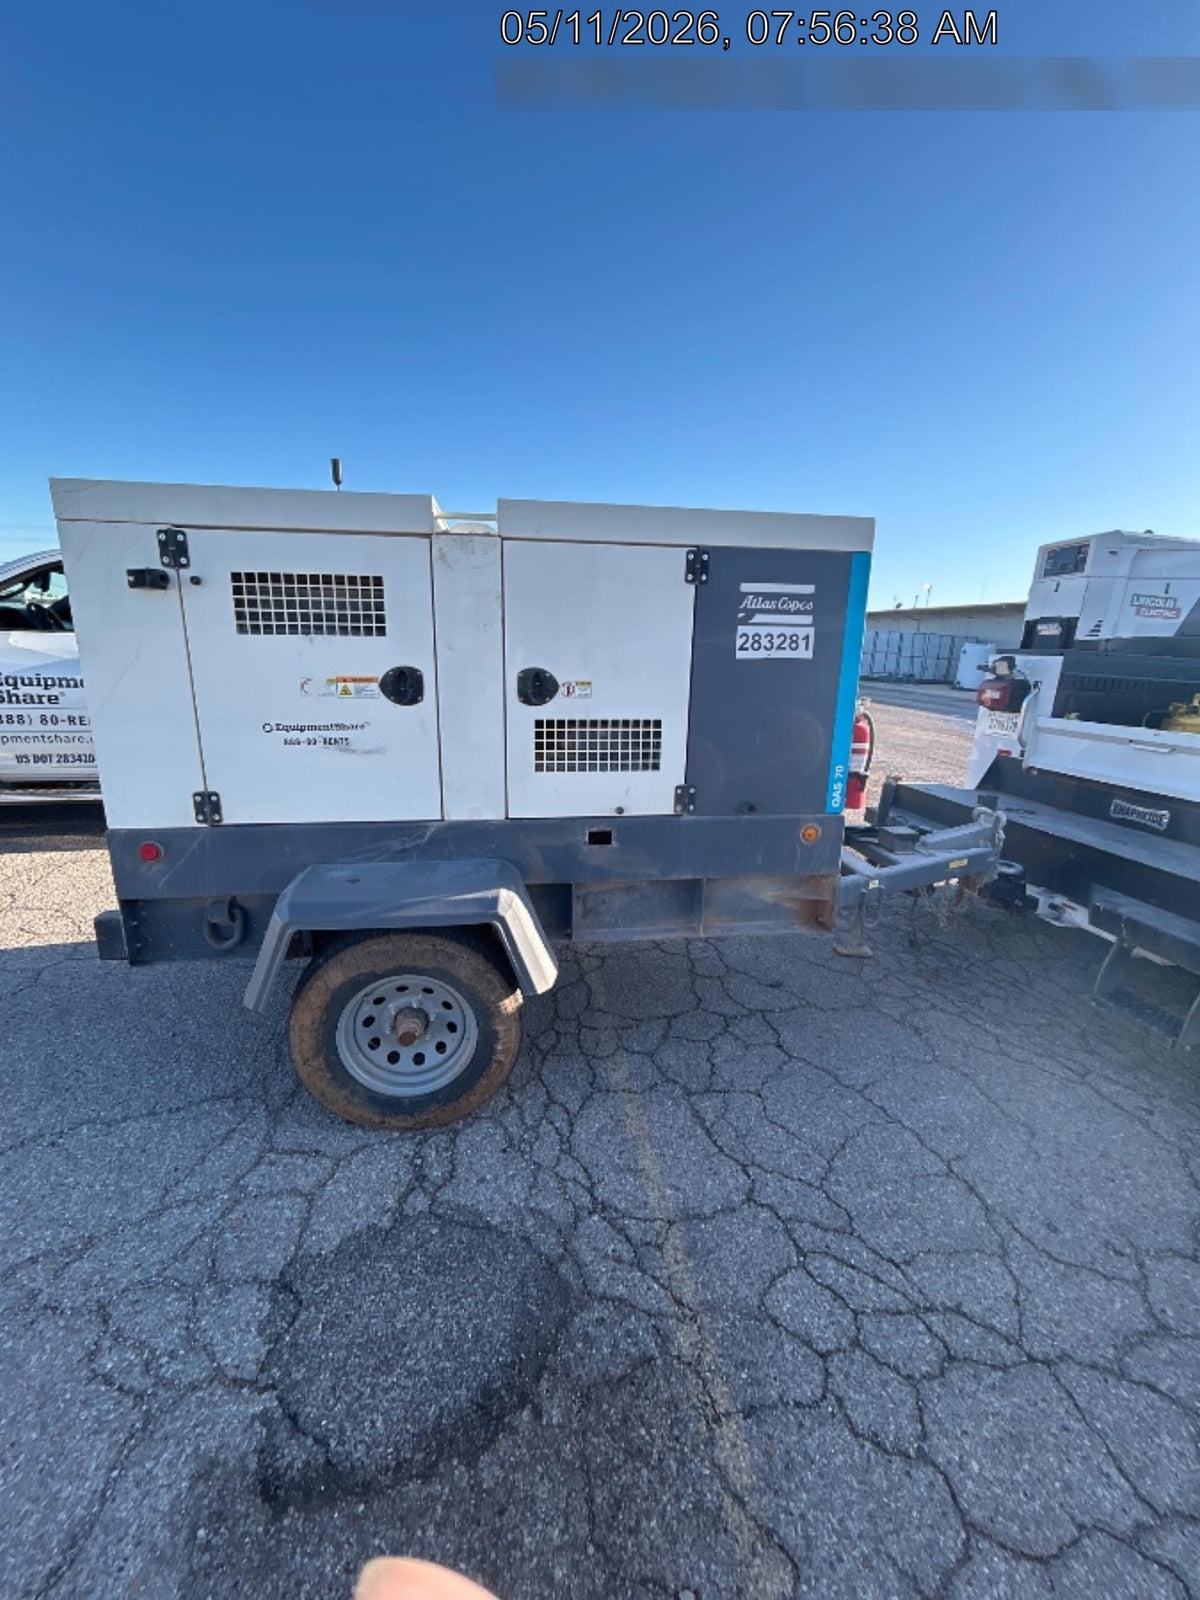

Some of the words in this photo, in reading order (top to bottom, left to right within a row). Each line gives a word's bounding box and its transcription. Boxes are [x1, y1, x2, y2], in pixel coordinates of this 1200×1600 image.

[739, 595, 776, 609] Atlas
[778, 597, 814, 612] Copco
[737, 633, 811, 652] 283281
[39, 714, 91, 727] 80-RE
